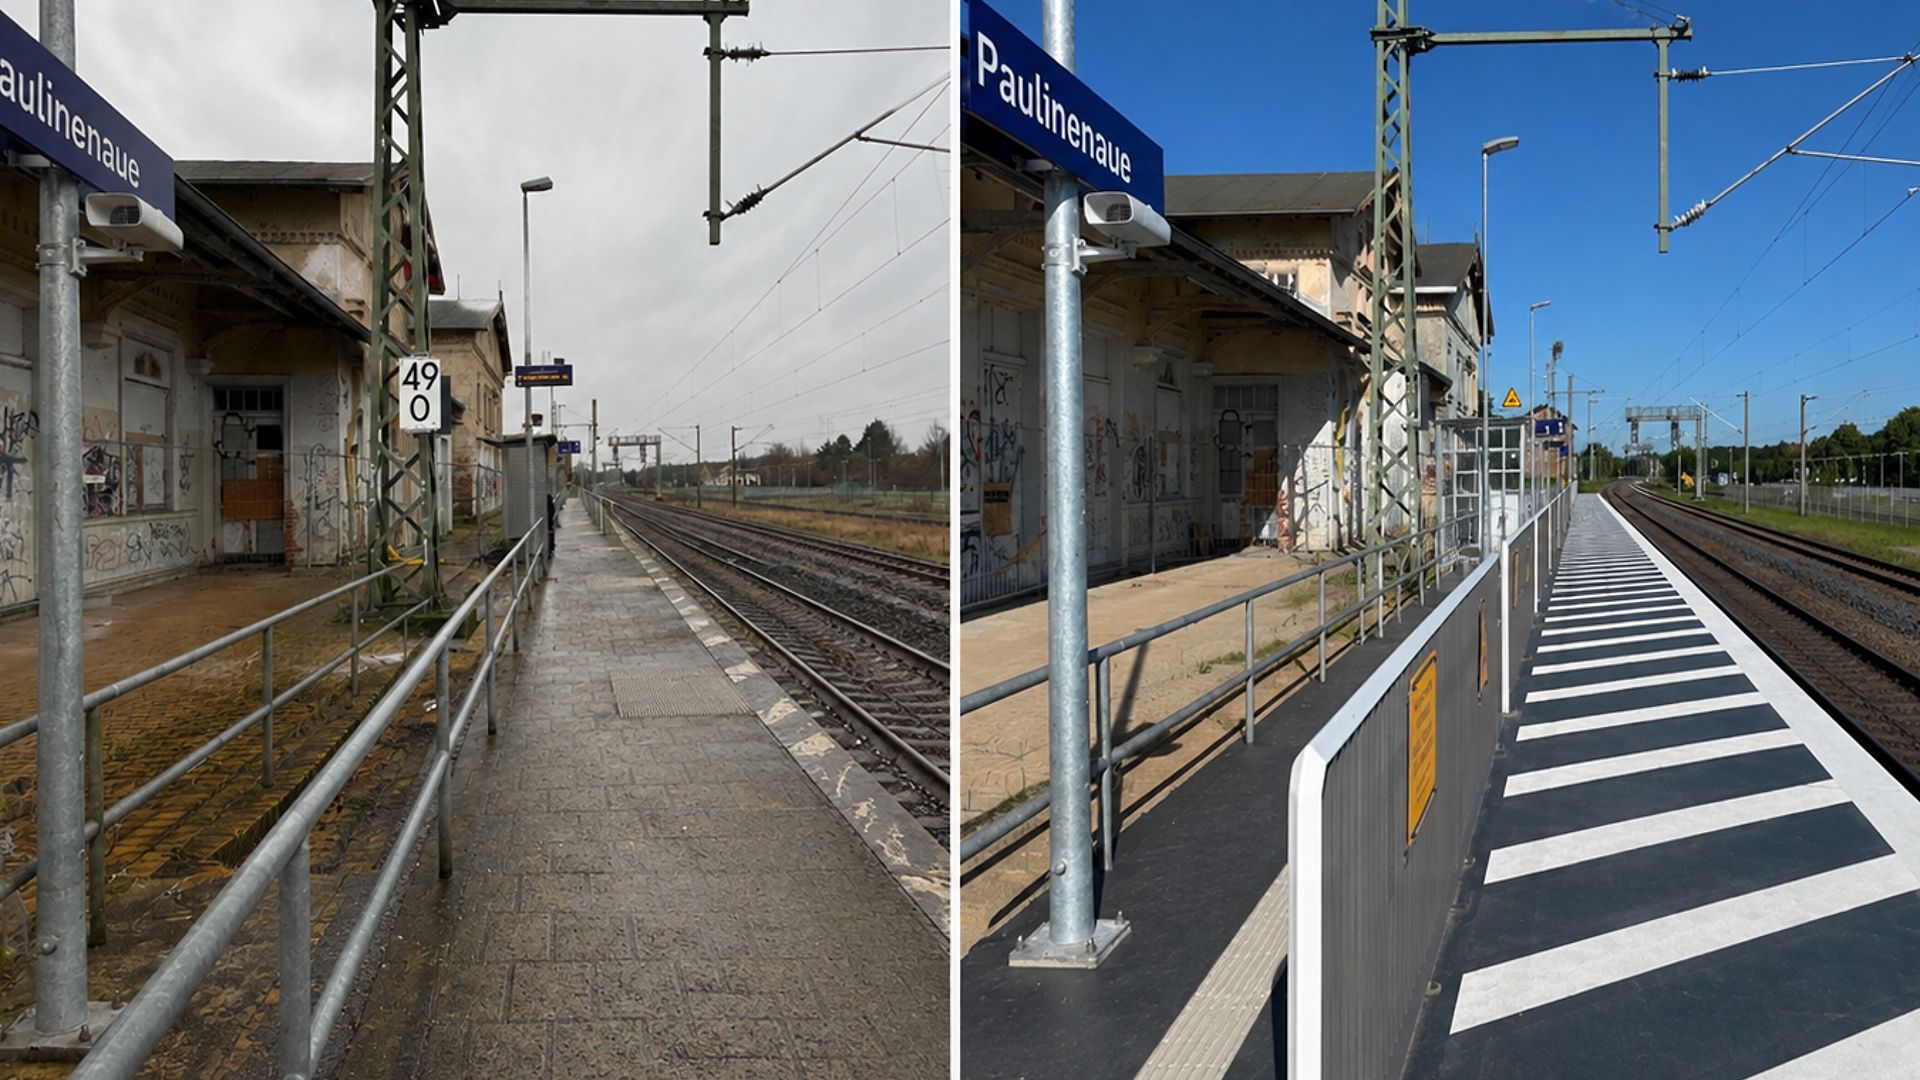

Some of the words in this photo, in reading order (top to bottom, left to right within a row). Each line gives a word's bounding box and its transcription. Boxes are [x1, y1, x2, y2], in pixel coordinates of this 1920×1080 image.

[977, 31, 1132, 184] Paulinenaue
[402, 362, 439, 390] 49
[410, 394, 430, 422] 0
